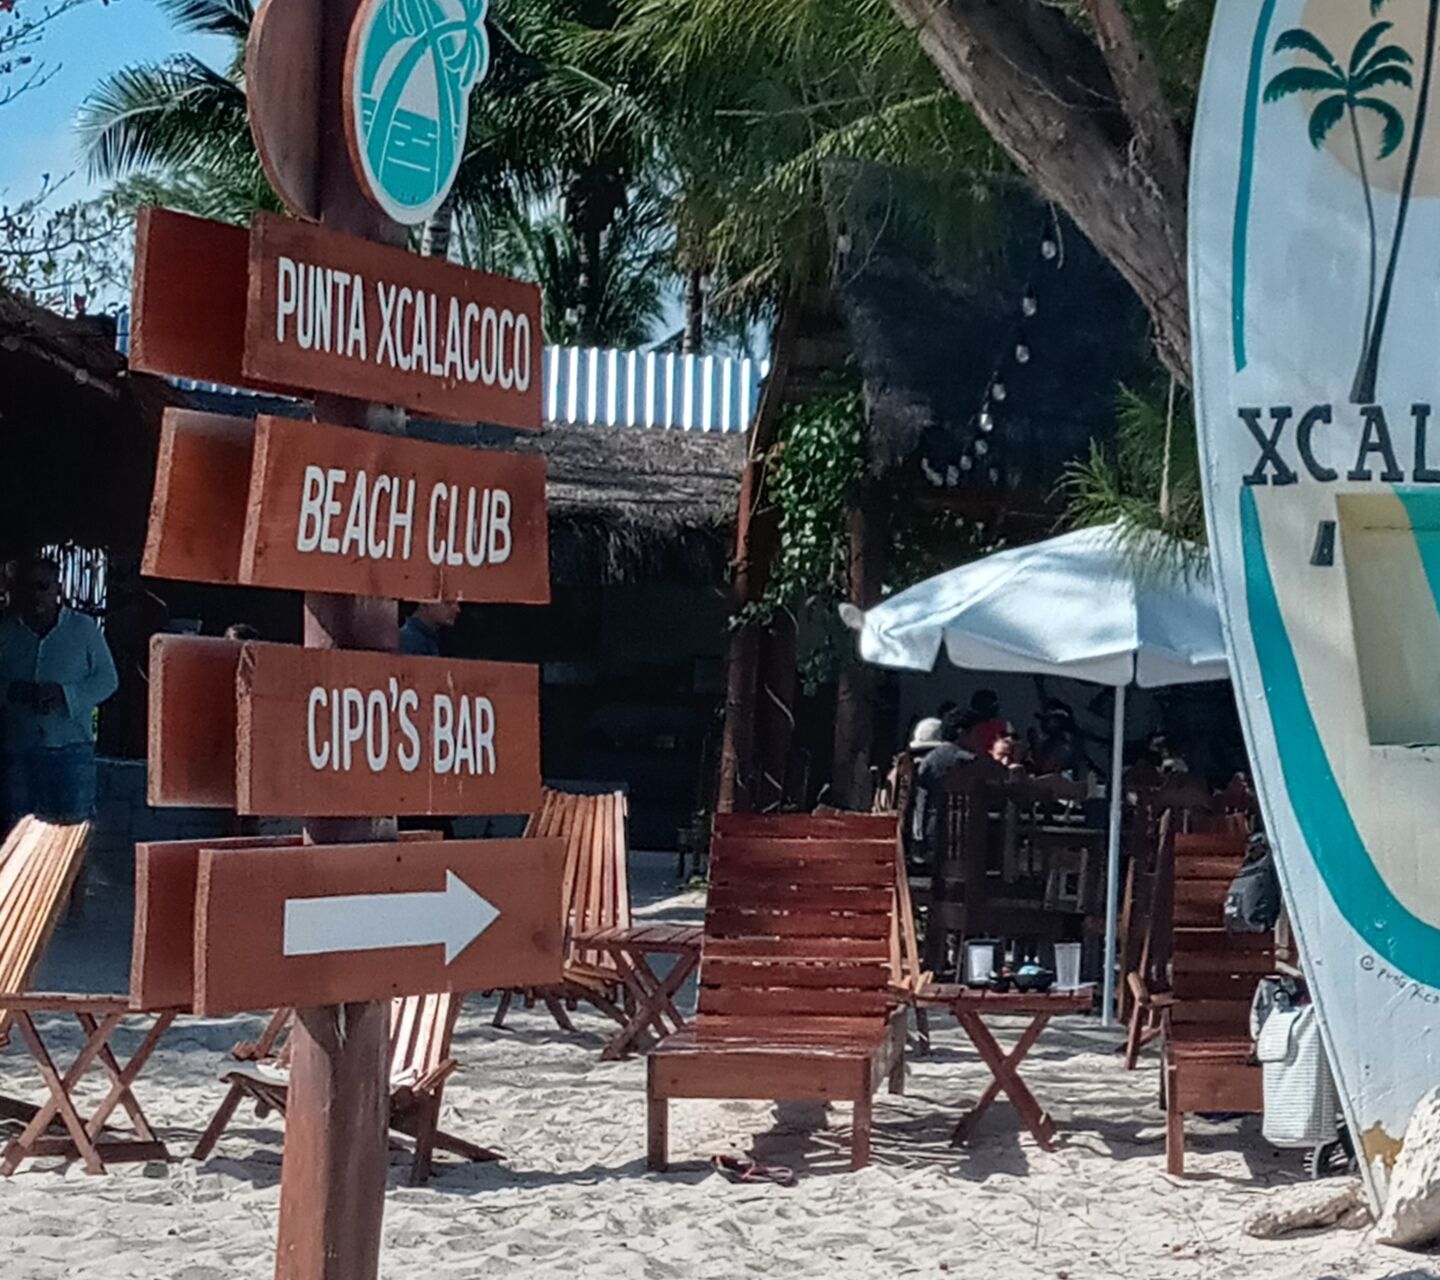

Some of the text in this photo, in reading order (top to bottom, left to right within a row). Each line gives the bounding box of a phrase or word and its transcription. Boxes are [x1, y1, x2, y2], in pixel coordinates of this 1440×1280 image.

[277, 256, 531, 392] PUNTA XCALACOCO
[297, 465, 513, 567] BEACH CLUB
[307, 677, 496, 776] CIPO'S BAR
